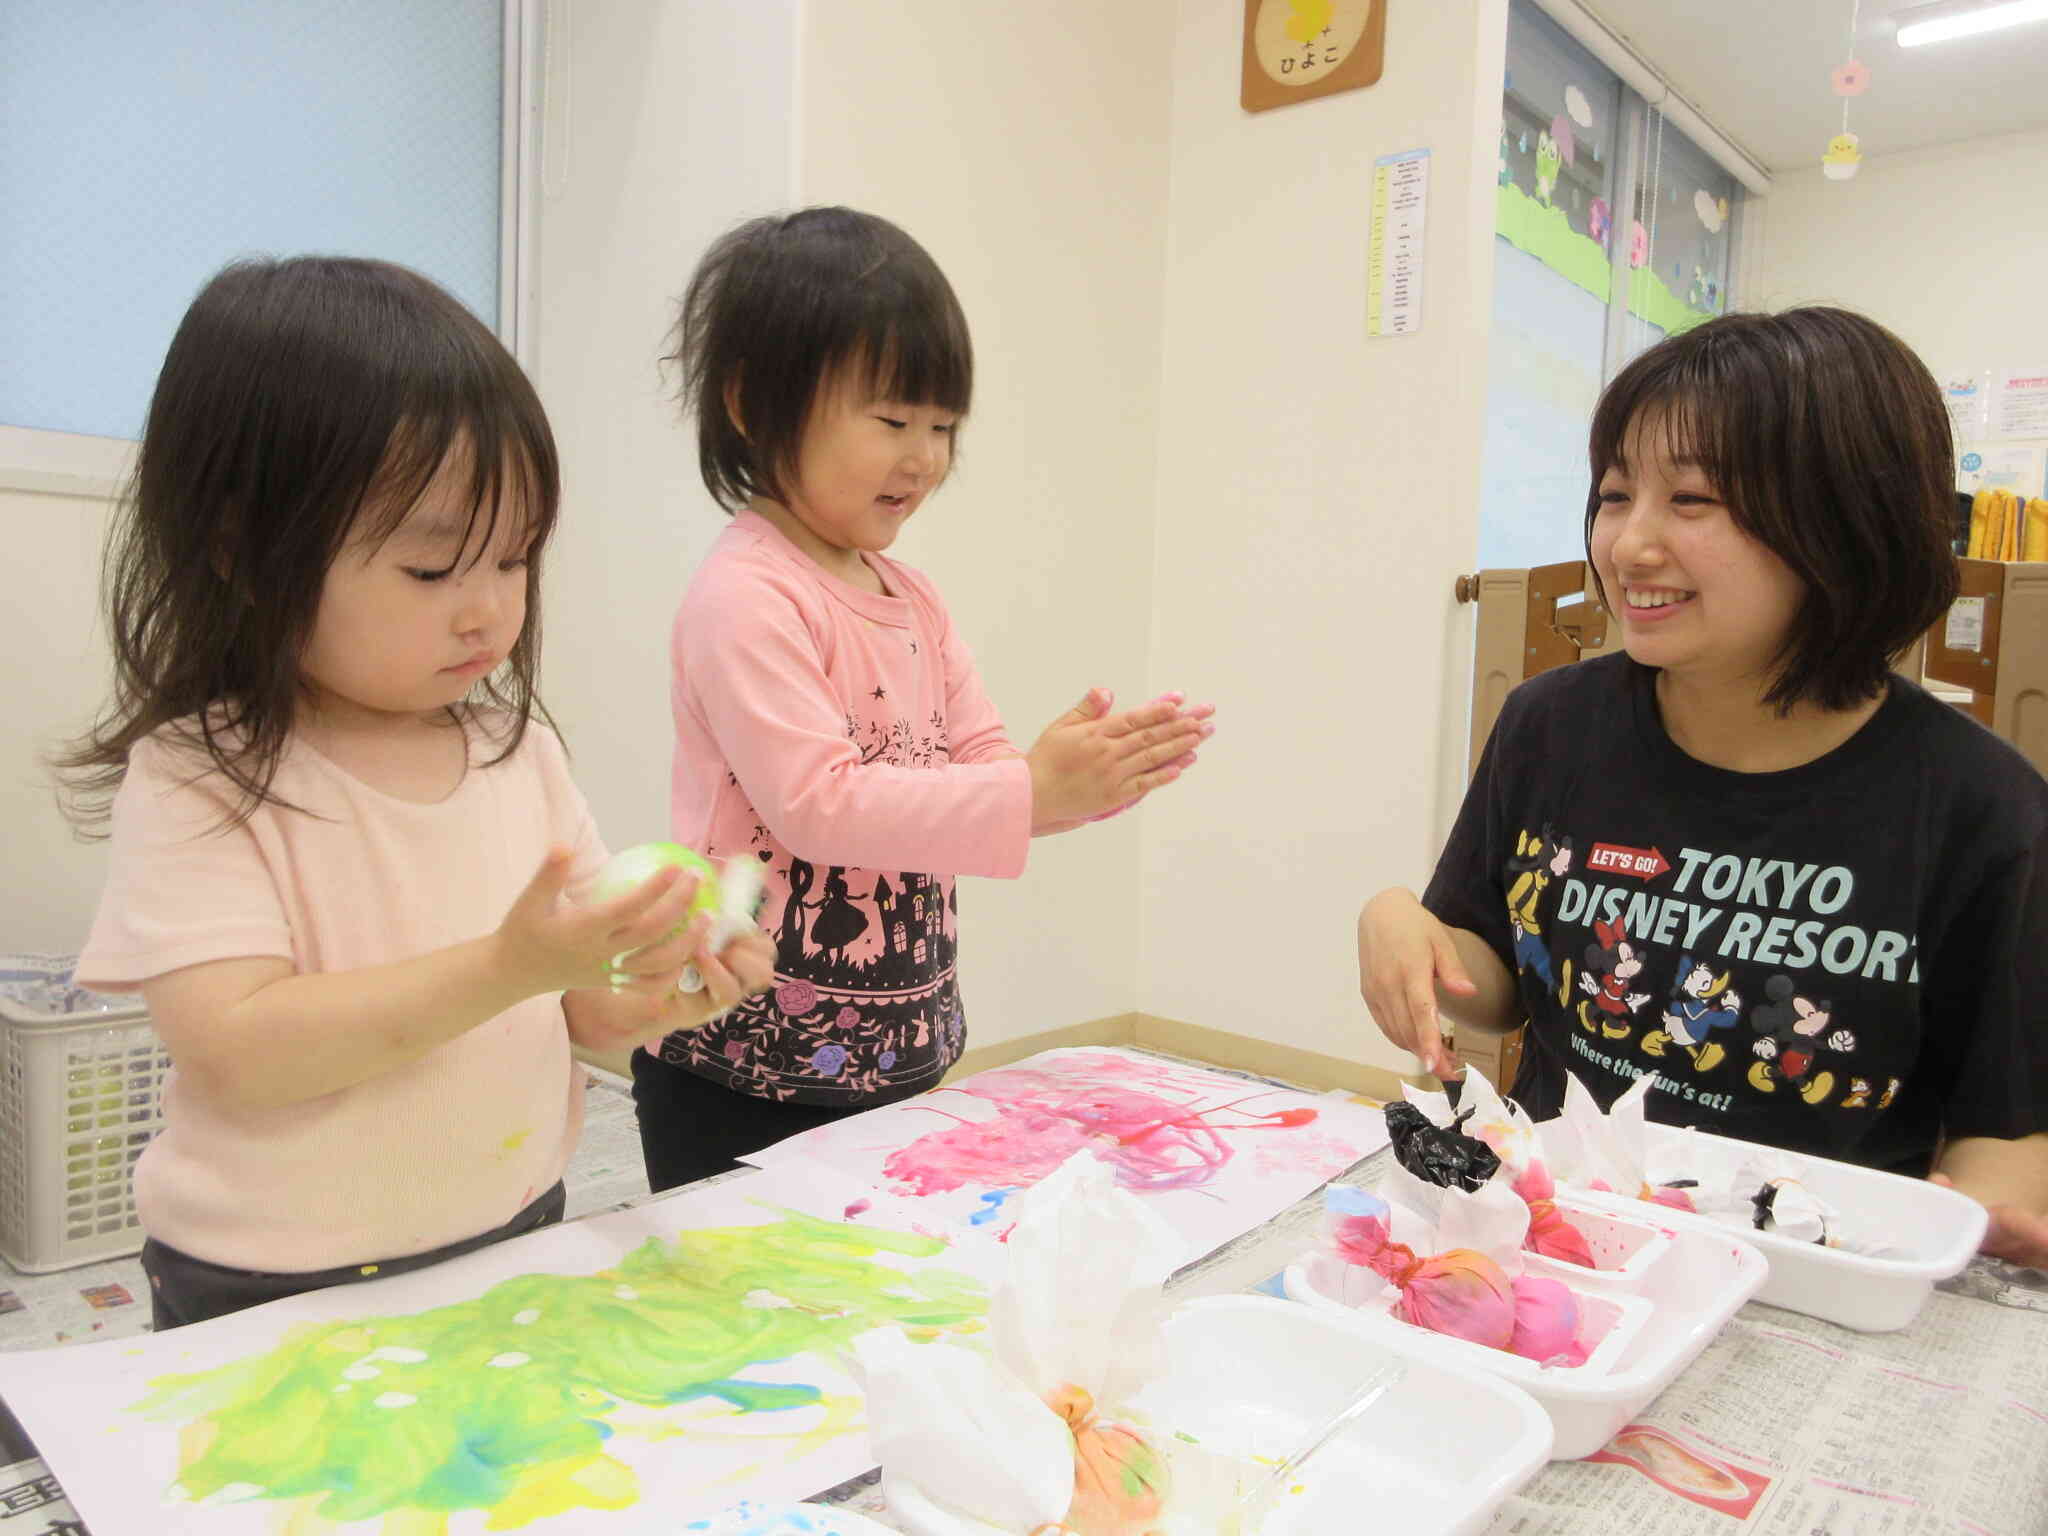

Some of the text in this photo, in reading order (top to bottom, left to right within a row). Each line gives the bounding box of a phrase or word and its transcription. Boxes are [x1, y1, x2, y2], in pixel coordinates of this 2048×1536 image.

[1280, 46, 1339, 74] ひよこ
[1591, 848, 1659, 873] LET'S GO!
[1672, 847, 1854, 915] TOKYO
[1557, 878, 1716, 950] DISNEY
[1571, 1032, 1612, 1070] Where
[1613, 1057, 1645, 1080] the
[1698, 1091, 1733, 1112] at!
